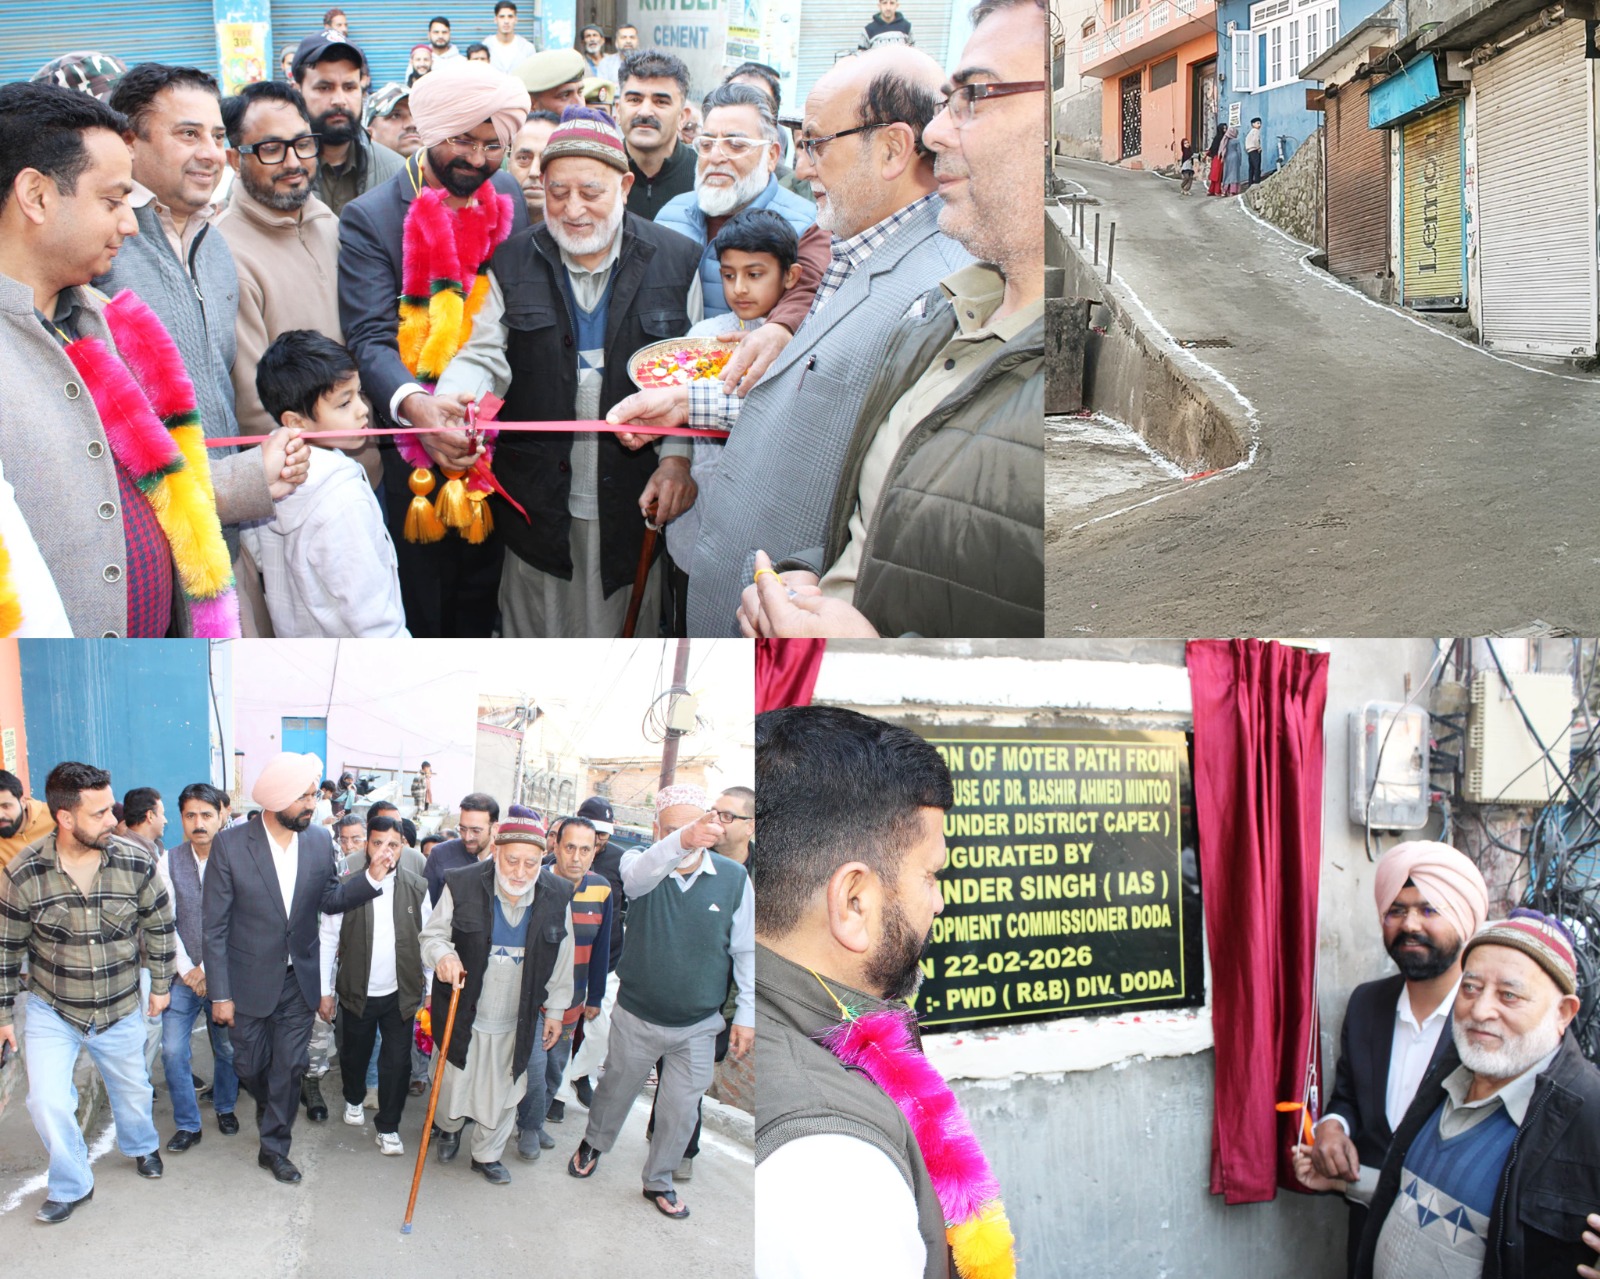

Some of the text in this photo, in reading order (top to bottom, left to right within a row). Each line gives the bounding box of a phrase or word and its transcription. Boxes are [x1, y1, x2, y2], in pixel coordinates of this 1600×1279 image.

[654, 25, 709, 49] CEMENT
[970, 746, 997, 771] OF
[1002, 746, 1070, 771] MOTER
[1074, 747, 1121, 772] PATH
[1125, 748, 1174, 773] FROM
[983, 779, 1001, 806] OF
[1004, 779, 1026, 806] DR.
[1029, 778, 1077, 805] BASHIR
[1080, 779, 1122, 804] AHMED
[1125, 780, 1171, 804] MINTOO
[1014, 811, 1099, 836] DISTRICT
[1103, 810, 1160, 833] CAPEX
[1064, 843, 1094, 865] BY
[1020, 873, 1096, 901] SINGH
[1118, 871, 1155, 896] IAS
[929, 904, 1172, 943] OPMENT COMMISSIONER DODA
[945, 946, 1093, 978] 22-02-2026
[946, 985, 996, 1011] PWD
[1017, 979, 1070, 1005] R&B)
[1076, 975, 1115, 997] DIV.
[1121, 969, 1175, 993] DODA
